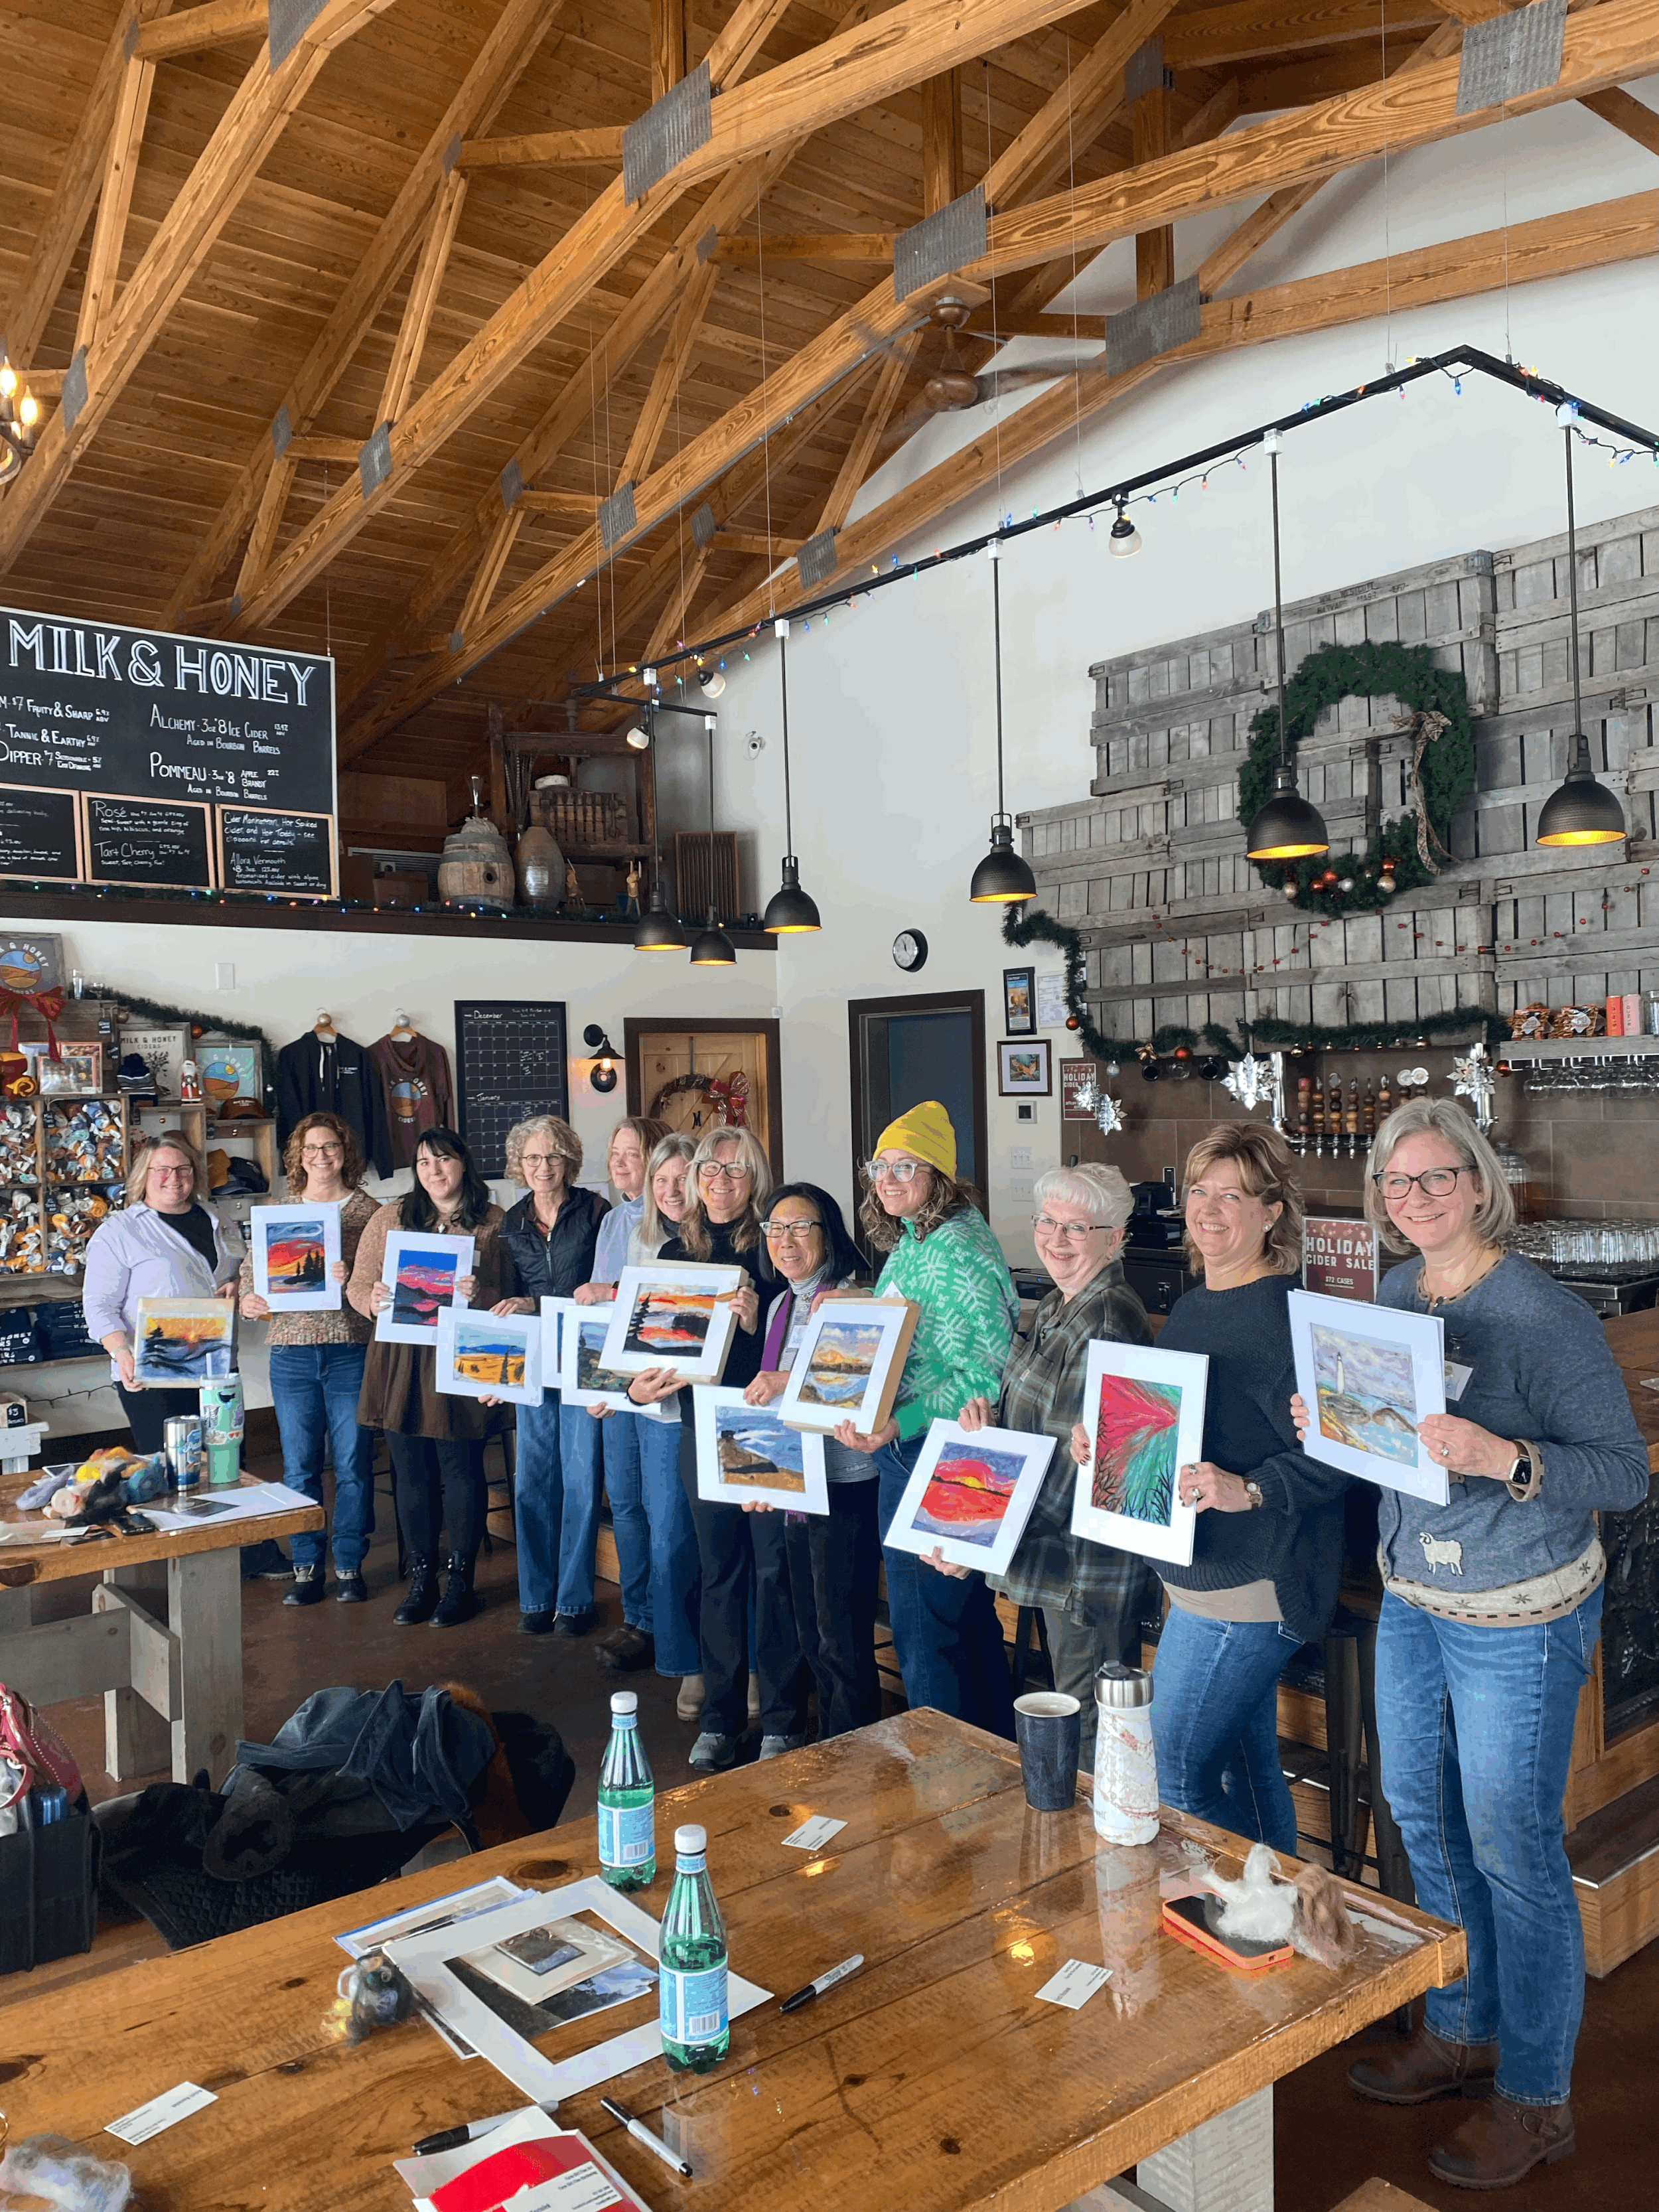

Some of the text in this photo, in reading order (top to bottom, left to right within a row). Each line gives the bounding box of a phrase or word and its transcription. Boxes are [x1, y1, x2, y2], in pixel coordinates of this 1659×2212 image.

[9, 619, 317, 705] MILK & HONEY
[41, 729, 50, 743] &
[92, 800, 127, 818] Rosé
[94, 840, 155, 860] Tart Cherry
[23, 943, 49, 967] HONEY
[474, 1010, 503, 1019] December
[1064, 1072, 1096, 1081] HOLIDAY
[476, 1092, 500, 1102] January
[1306, 1236, 1374, 1257] HOLIDAY
[1306, 1254, 1374, 1271] CIDER SALE
[8, 1408, 19, 1416] $3
